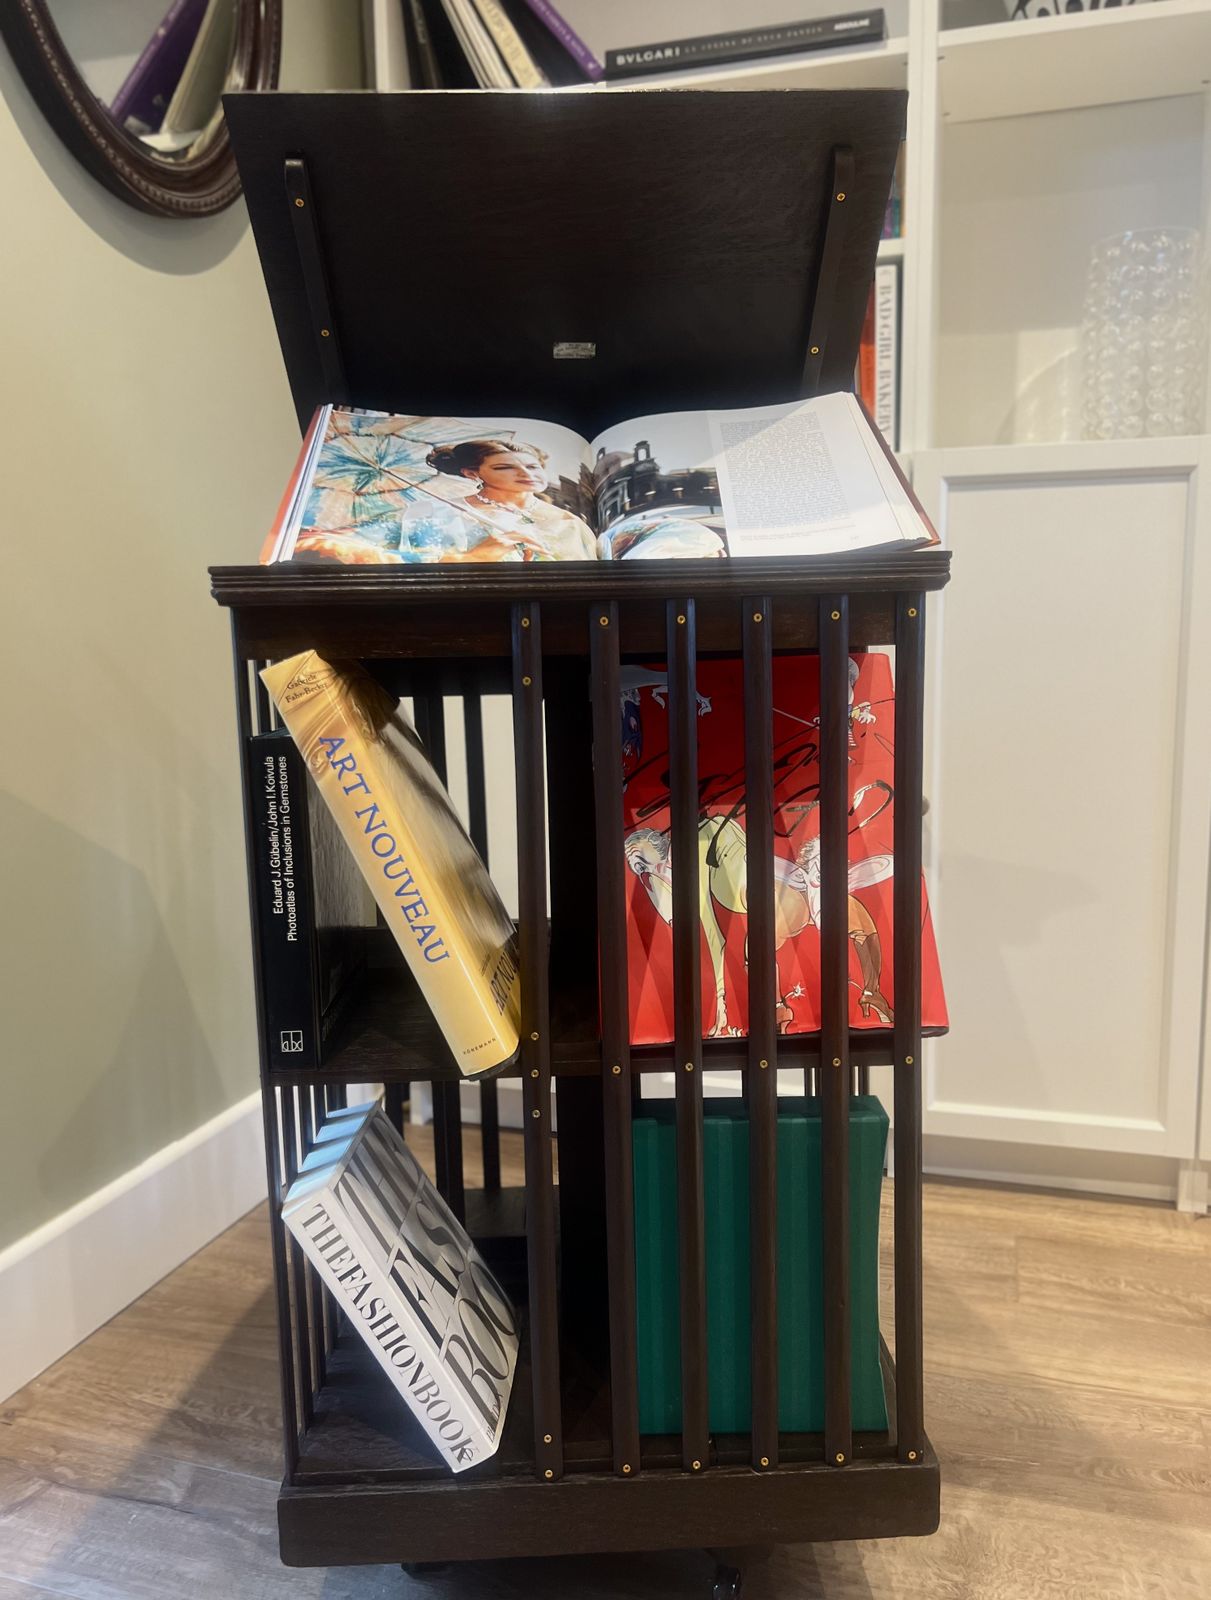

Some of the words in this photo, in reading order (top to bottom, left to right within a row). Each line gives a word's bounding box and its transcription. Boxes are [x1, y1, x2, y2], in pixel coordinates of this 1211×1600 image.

[616, 46, 680, 66] BVLGARI
[279, 756, 290, 814] Gemstones
[280, 816, 291, 825] in
[281, 827, 294, 875] Inclusions
[319, 737, 372, 797] ART
[355, 802, 450, 963] NOUVEAU
[273, 880, 284, 914] Eduard
[284, 878, 295, 889] of
[285, 890, 298, 941] Photoatlas
